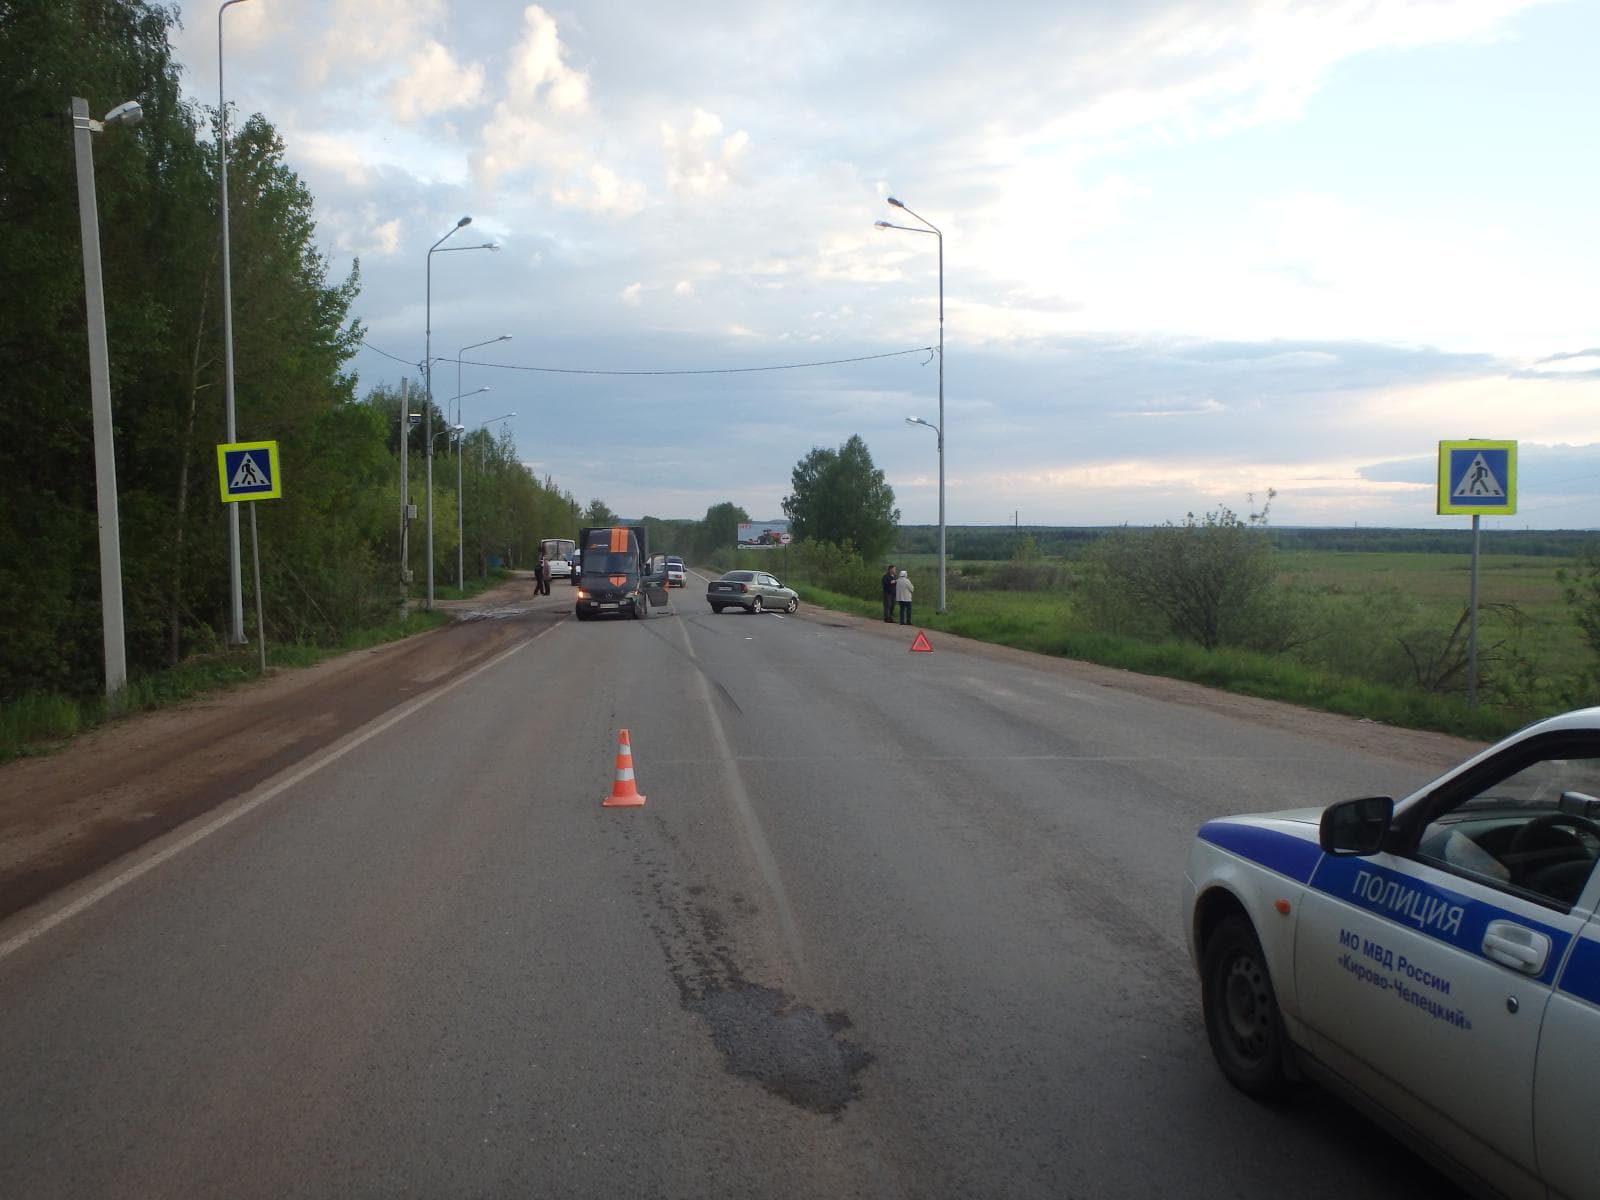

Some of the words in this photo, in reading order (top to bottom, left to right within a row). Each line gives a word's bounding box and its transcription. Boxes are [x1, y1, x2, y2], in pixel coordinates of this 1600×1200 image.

[1352, 870, 1464, 936] ПОЛИЦИЯ
[1339, 928, 1360, 952] МО
[1362, 941, 1394, 972] МВД
[1397, 955, 1451, 995] России
